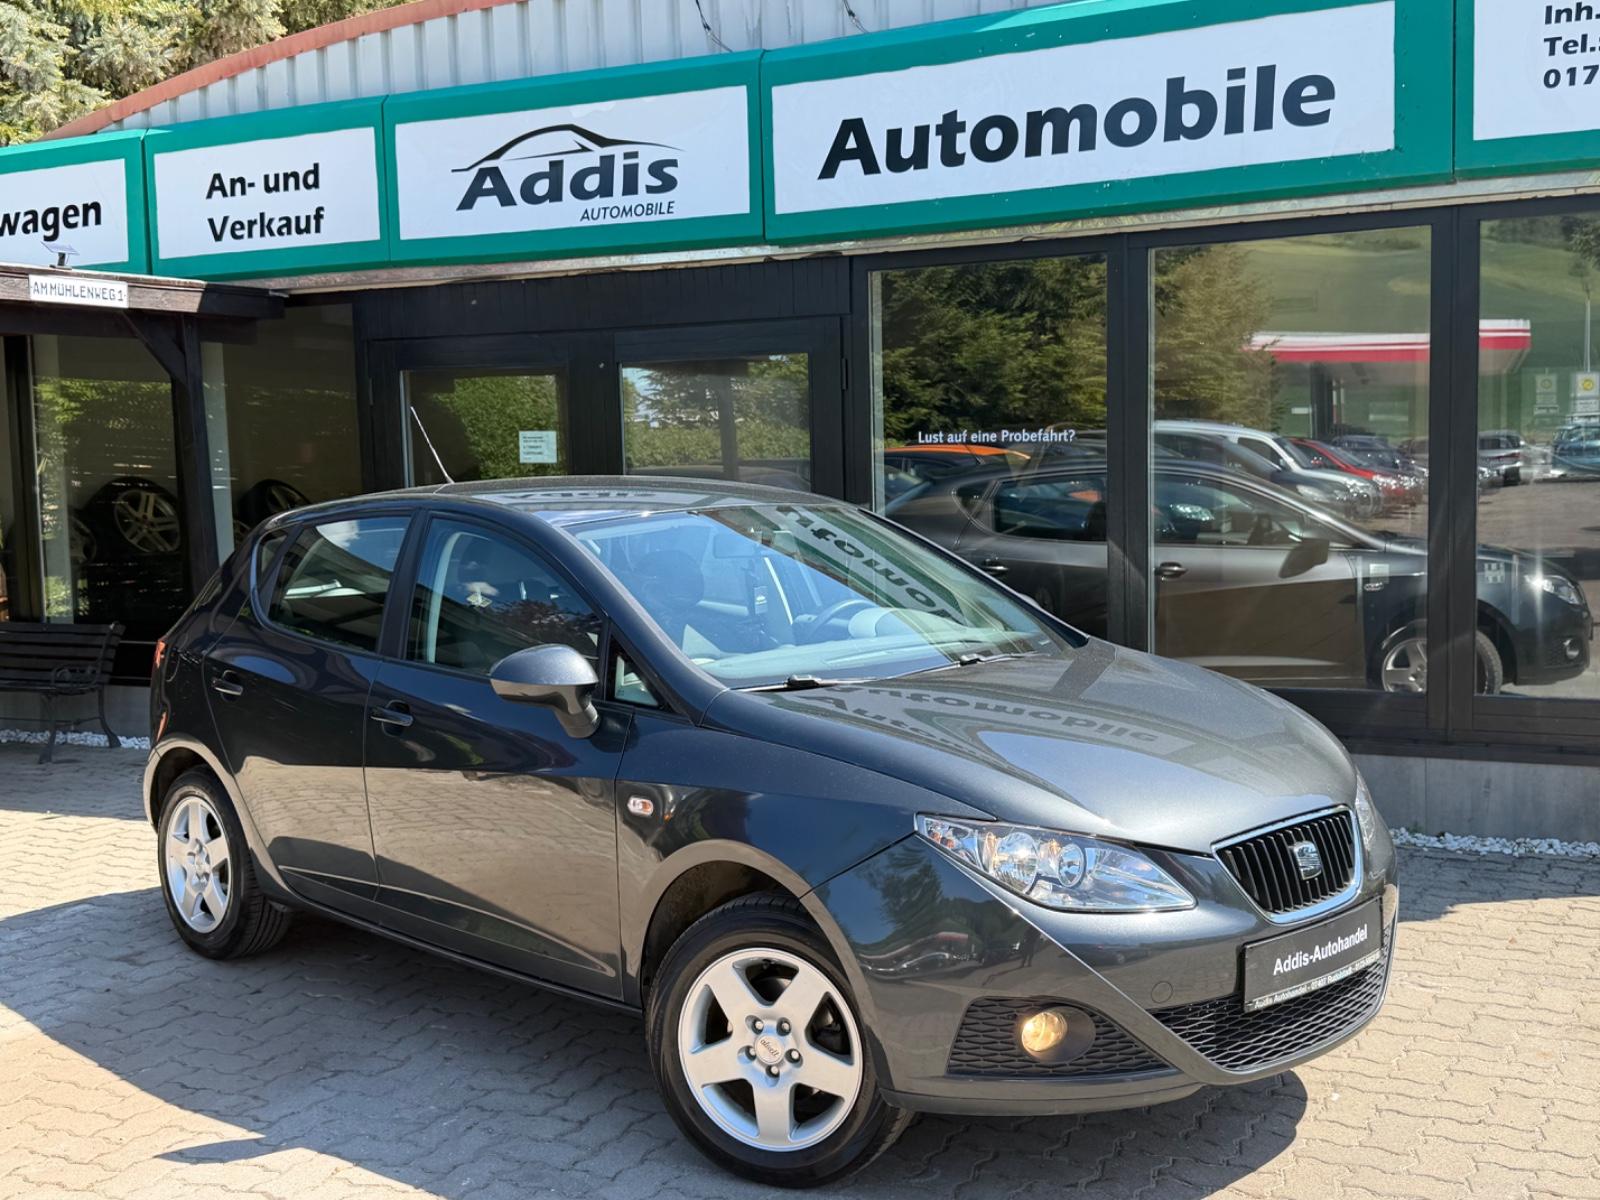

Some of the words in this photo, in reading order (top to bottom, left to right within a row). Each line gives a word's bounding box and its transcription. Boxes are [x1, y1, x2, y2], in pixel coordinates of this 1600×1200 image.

[1543, 33, 1600, 57] Tel.
[817, 64, 1336, 181] Automobile
[206, 172, 256, 200] An-
[263, 162, 320, 194] und
[456, 151, 678, 211] Addis
[207, 206, 325, 242] Verkauf
[580, 201, 675, 222] AUTOMOBILE
[918, 431, 944, 443] Lust
[947, 429, 968, 443] auf
[971, 430, 997, 442] eine
[1001, 428, 1076, 442] Probefahrt?
[1272, 923, 1368, 976] Addis-Autohandel
